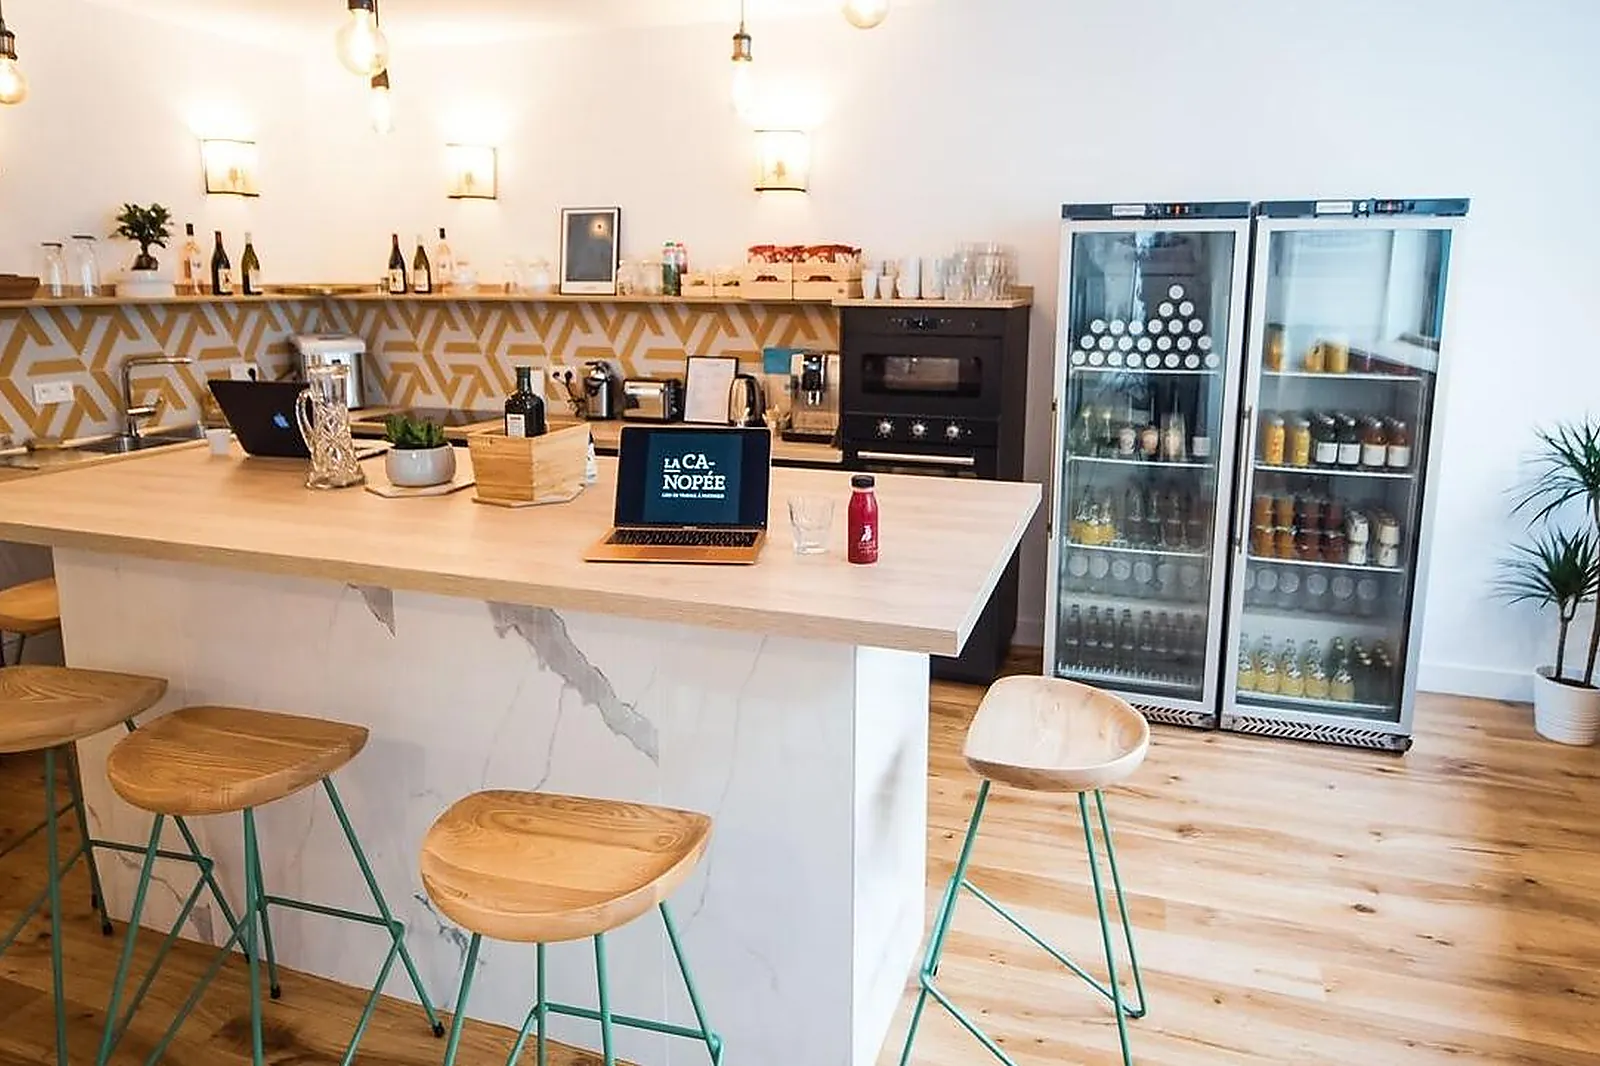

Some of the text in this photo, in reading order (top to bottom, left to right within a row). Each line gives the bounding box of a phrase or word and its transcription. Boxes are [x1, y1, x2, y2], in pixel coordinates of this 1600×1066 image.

[664, 453, 716, 469] LA CA-
[662, 470, 726, 490] NOPÉE
